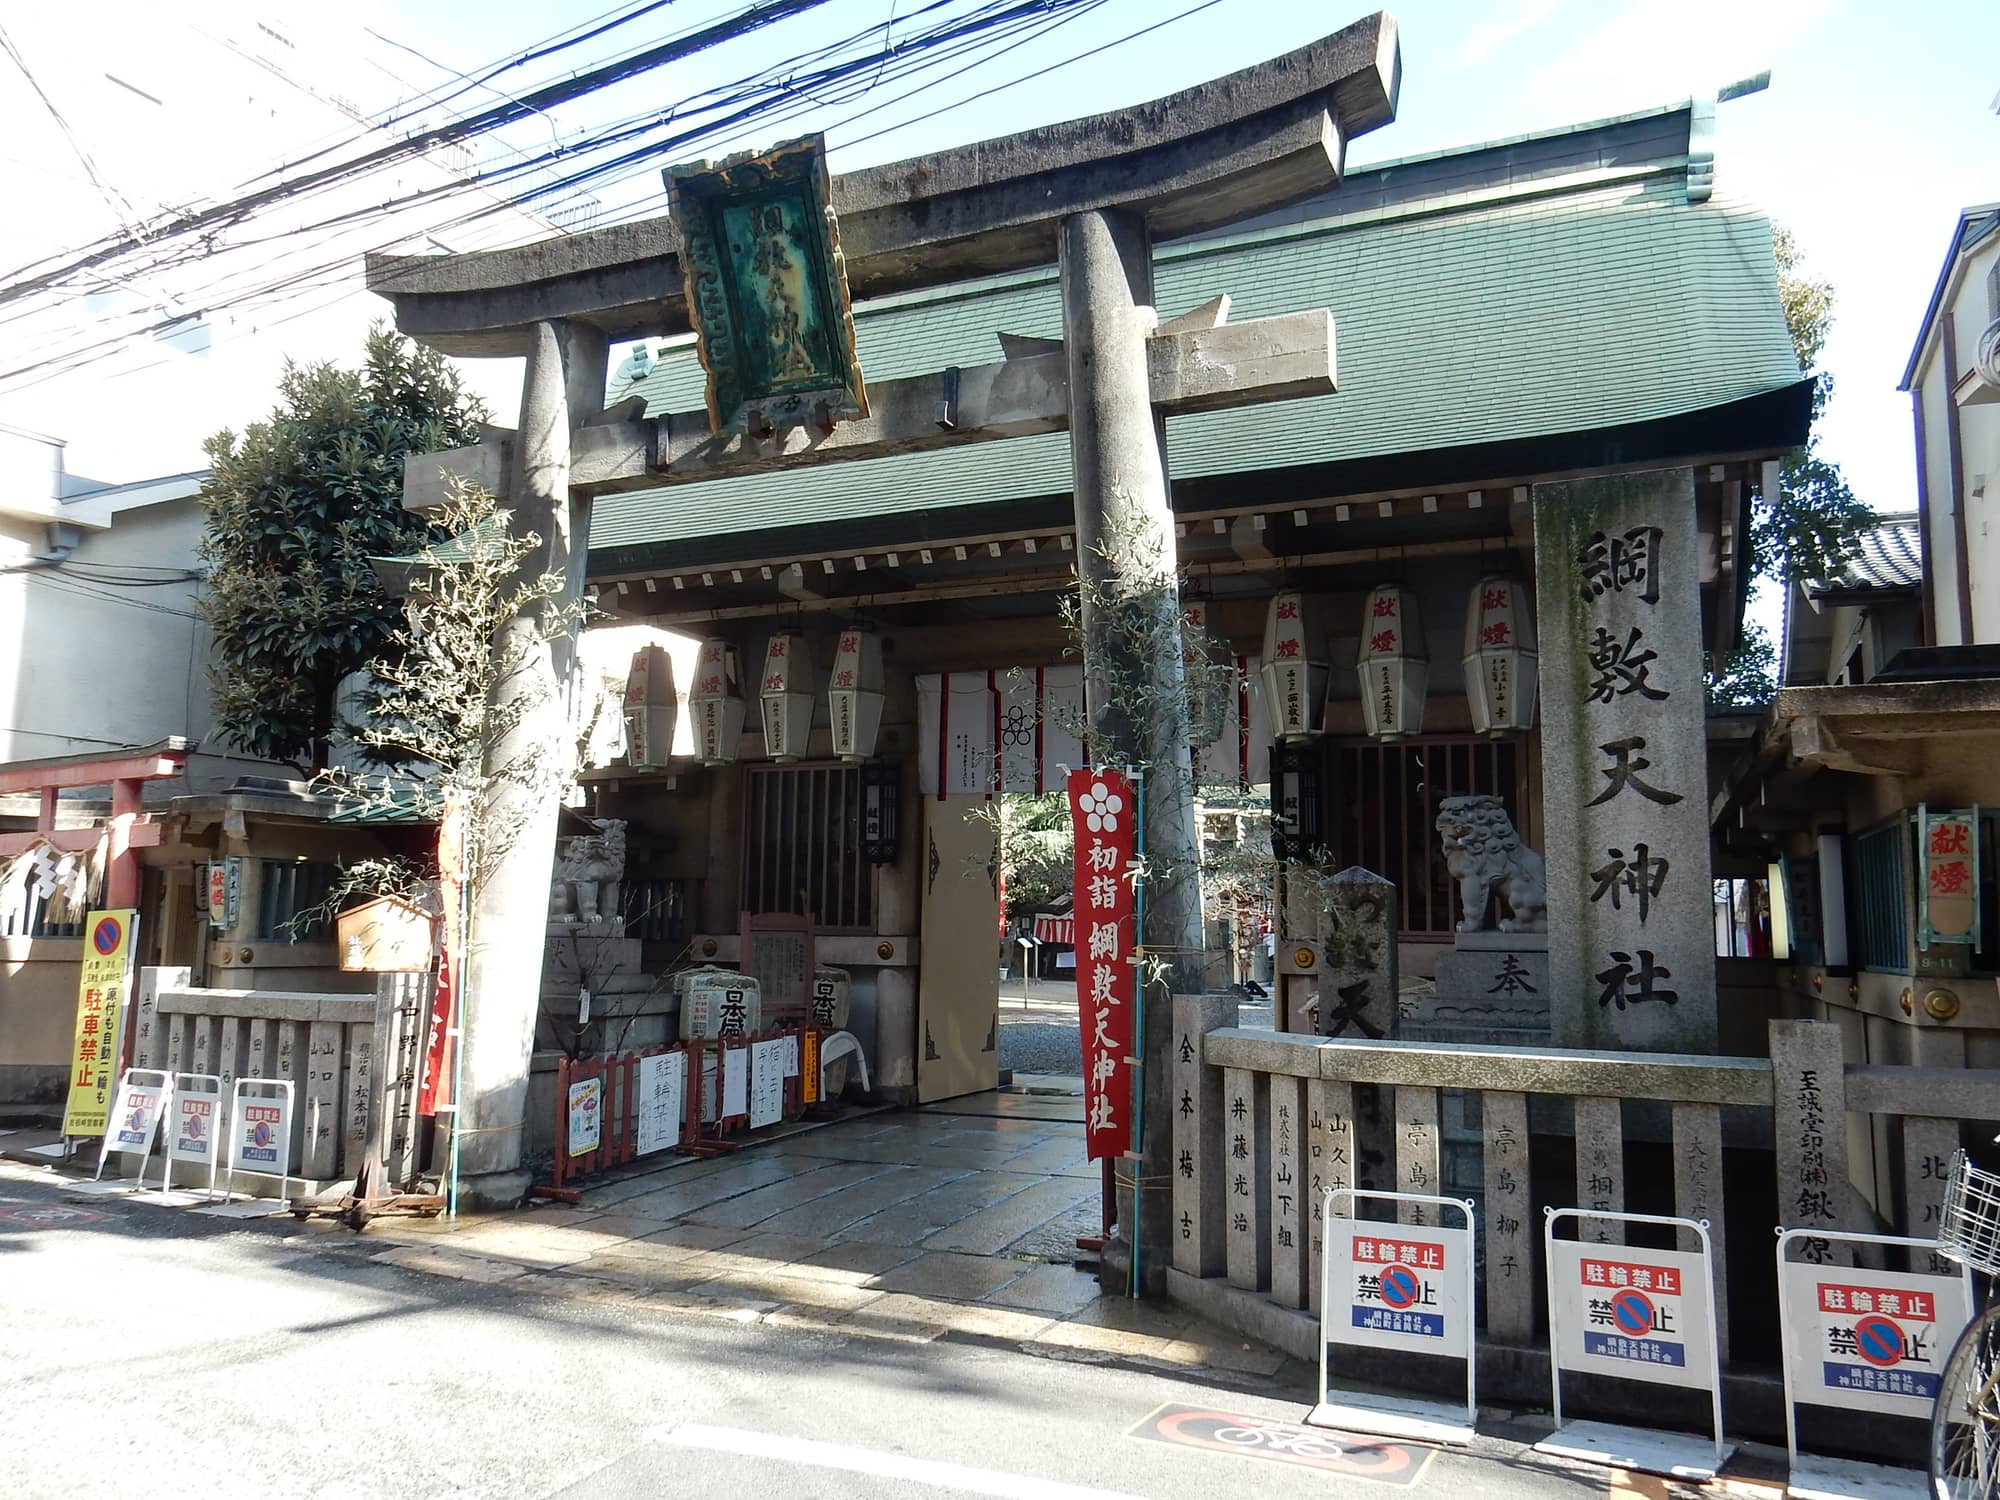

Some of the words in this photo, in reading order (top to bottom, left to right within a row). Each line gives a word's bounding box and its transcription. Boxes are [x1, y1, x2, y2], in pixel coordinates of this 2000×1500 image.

[1276, 601, 1301, 658] 献燈
[1370, 597, 1397, 652] 献燈
[1481, 589, 1511, 645] 献燈
[765, 641, 785, 690] 献燈
[835, 637, 858, 687] 献燈
[1577, 524, 1685, 1010] 綱敷天神社
[1085, 837, 1119, 910] 初詣
[1929, 822, 1971, 896] 献燈
[1486, 953, 1538, 997] 奉
[76, 988, 104, 1088] 駐車禁止
[96, 987, 118, 1105] 原付も自動二輪も
[1087, 920, 1122, 1137] 綱敷天神社
[1177, 1032, 1196, 1240] 金本梅吉
[1230, 1096, 1249, 1233] 井藤光治
[1357, 1240, 1440, 1268] 駐輪禁止
[1585, 1262, 1678, 1292] 駐輪禁止
[1357, 1273, 1381, 1302] 禁
[1588, 1298, 1615, 1326] 禁
[1823, 1287, 1931, 1318] 駐輪禁止
[1827, 1326, 1858, 1356] 禁
